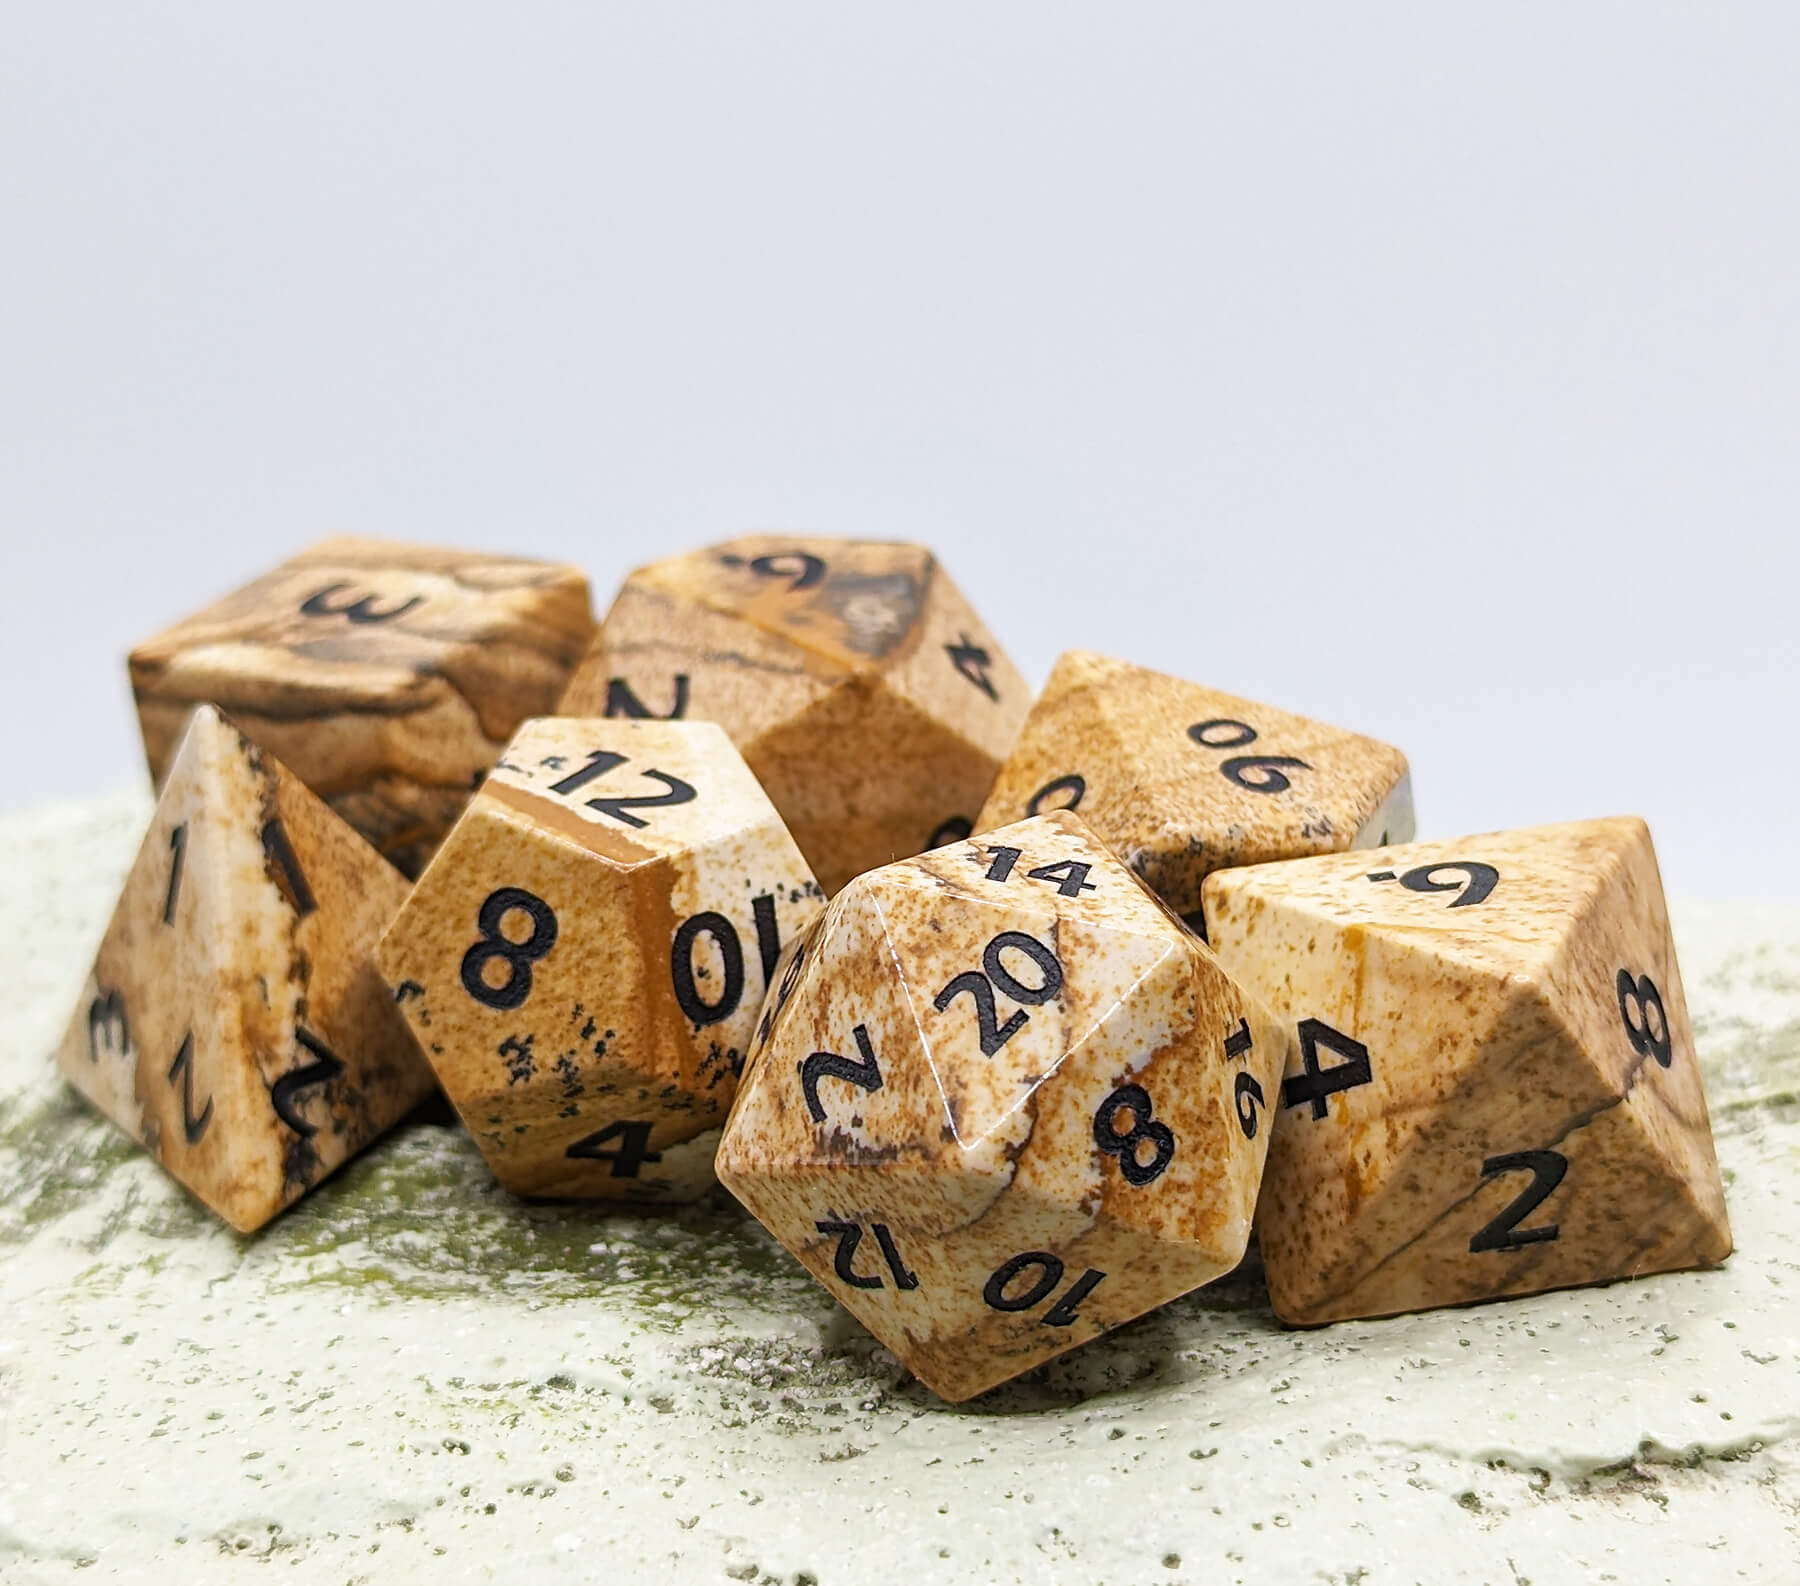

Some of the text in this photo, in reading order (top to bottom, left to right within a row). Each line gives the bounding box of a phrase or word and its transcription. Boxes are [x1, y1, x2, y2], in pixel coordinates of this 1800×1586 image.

[300, 583, 424, 625] 3
[943, 630, 999, 701] 4
[548, 750, 698, 829] 12
[164, 821, 188, 926] 1
[261, 810, 320, 920] 1
[985, 846, 1097, 898] 14
[460, 886, 559, 1011] 8
[671, 893, 788, 1027] 10
[933, 931, 1066, 1059] 20
[89, 985, 131, 1063] 3
[1281, 1017, 1373, 1122] 4
[1617, 968, 1673, 1068] 8
[167, 1028, 214, 1146] 2
[271, 1023, 345, 1137] 2
[798, 1024, 884, 1123] 2
[1223, 1017, 1266, 1141] 16
[565, 1120, 663, 1179] 4
[1092, 1083, 1176, 1186] 8
[1469, 1150, 1568, 1253] 2
[815, 1220, 921, 1292] 12
[982, 1250, 1107, 1328] 10
